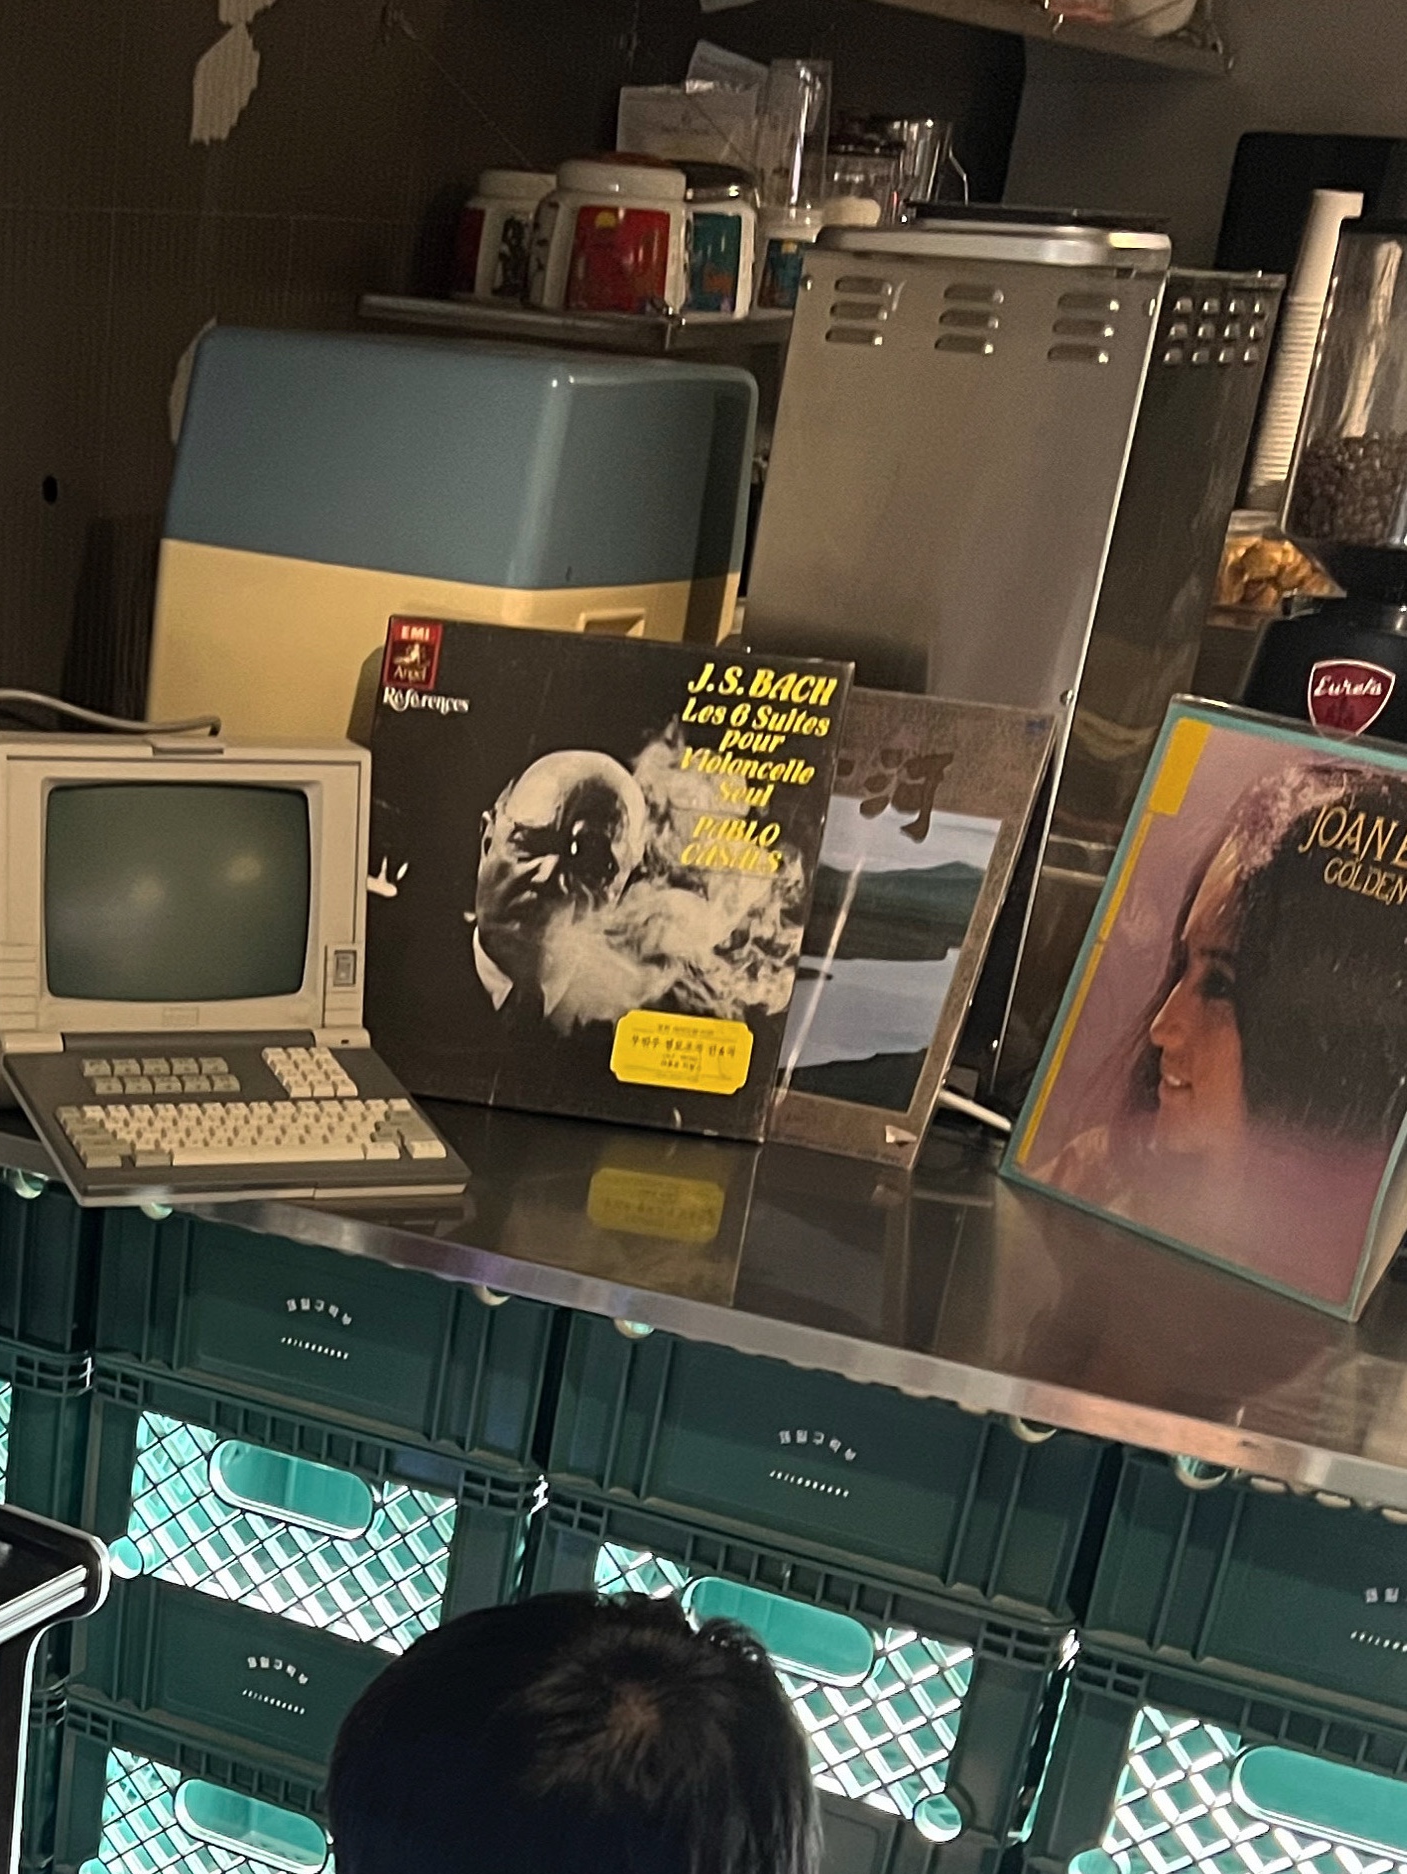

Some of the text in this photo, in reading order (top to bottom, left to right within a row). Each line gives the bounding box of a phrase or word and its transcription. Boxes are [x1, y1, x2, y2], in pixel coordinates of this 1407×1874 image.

[401, 625, 430, 641] EMI
[749, 668, 838, 706] BACH
[681, 697, 830, 737] Les 6 Suites
[719, 729, 785, 753] pour
[680, 747, 815, 785] Violoncelle
[720, 780, 775, 807] Seul
[693, 816, 781, 847] PABLO
[1298, 805, 1399, 861] JOAN
[1324, 857, 1407, 905] GOLDEN
